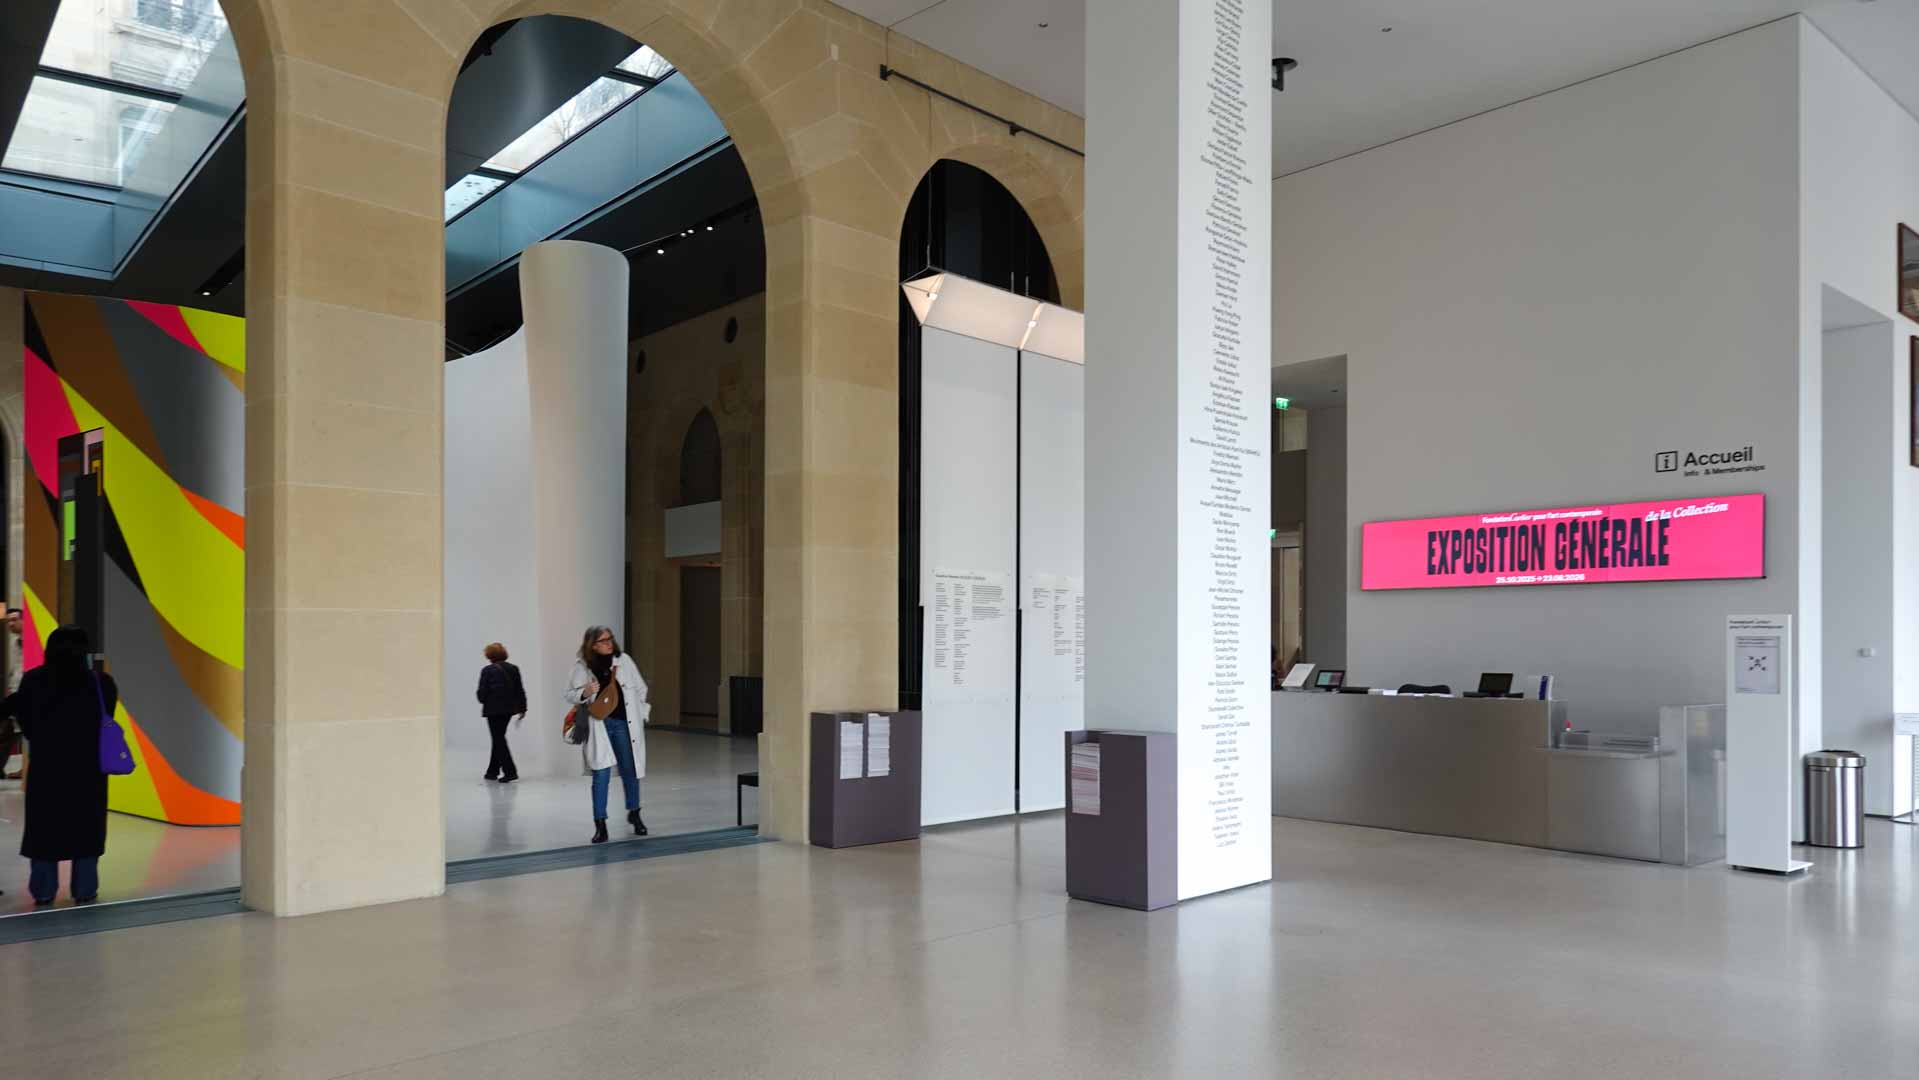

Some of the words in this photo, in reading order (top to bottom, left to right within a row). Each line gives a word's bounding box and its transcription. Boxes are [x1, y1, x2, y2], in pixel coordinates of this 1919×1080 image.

[1684, 446, 1752, 466] Accueil
[1645, 511, 1659, 522] de
[1660, 510, 1671, 520] la
[1673, 503, 1728, 518] Collection
[1427, 524, 1546, 575] EXPOSITION
[1554, 517, 1670, 571] GÉNÉRALE
